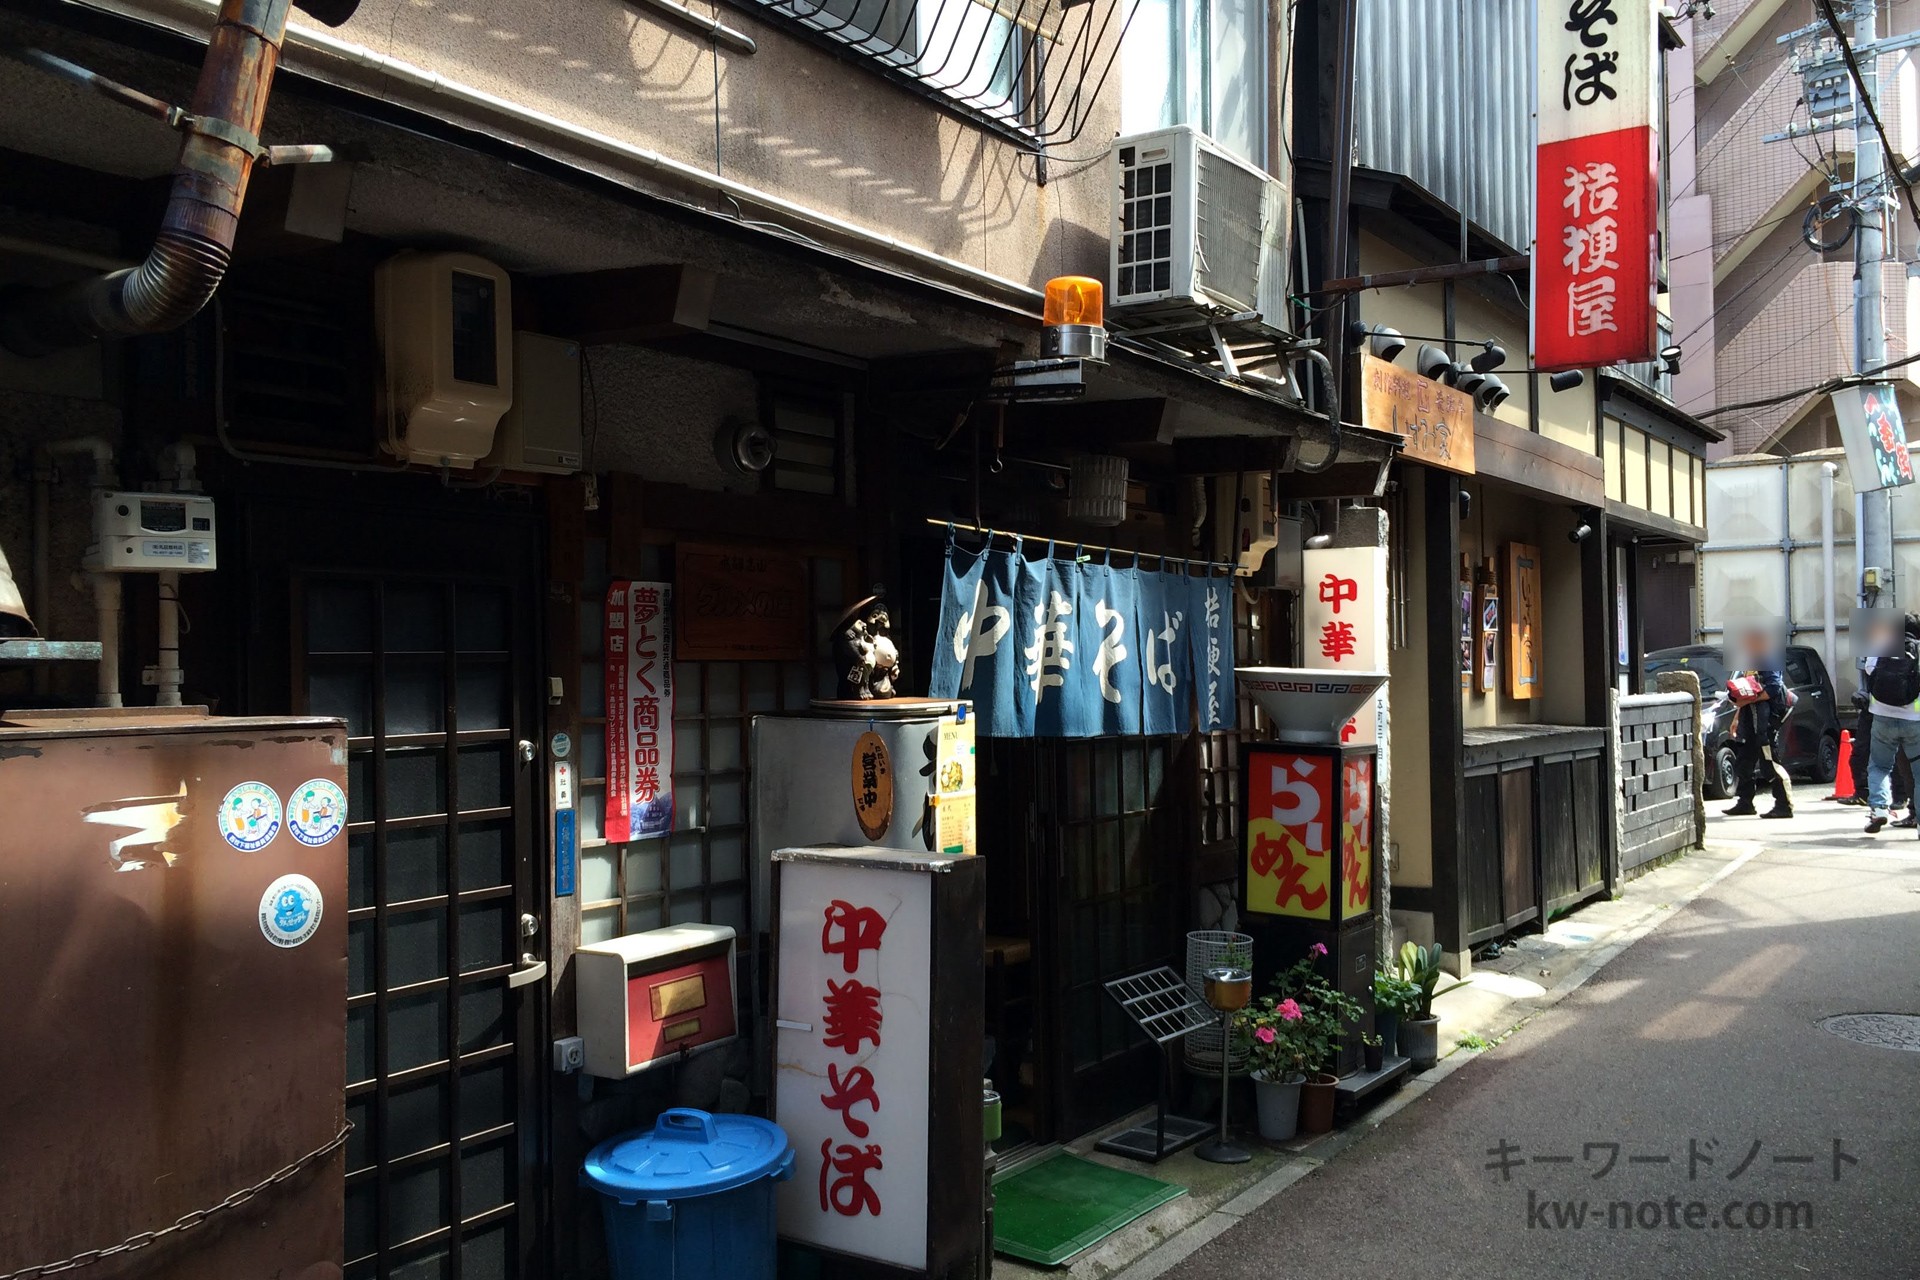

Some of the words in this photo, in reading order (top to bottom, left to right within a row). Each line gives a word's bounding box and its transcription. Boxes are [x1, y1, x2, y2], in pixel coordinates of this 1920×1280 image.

[1564, 0, 1618, 112] そば
[1563, 162, 1619, 338] 桔梗屋
[608, 589, 625, 653] 加盟店
[953, 578, 1182, 704] 中華そば
[632, 586, 661, 804] 夢とく商品券
[862, 751, 878, 808] 営業中
[820, 899, 887, 1217] 中華そば
